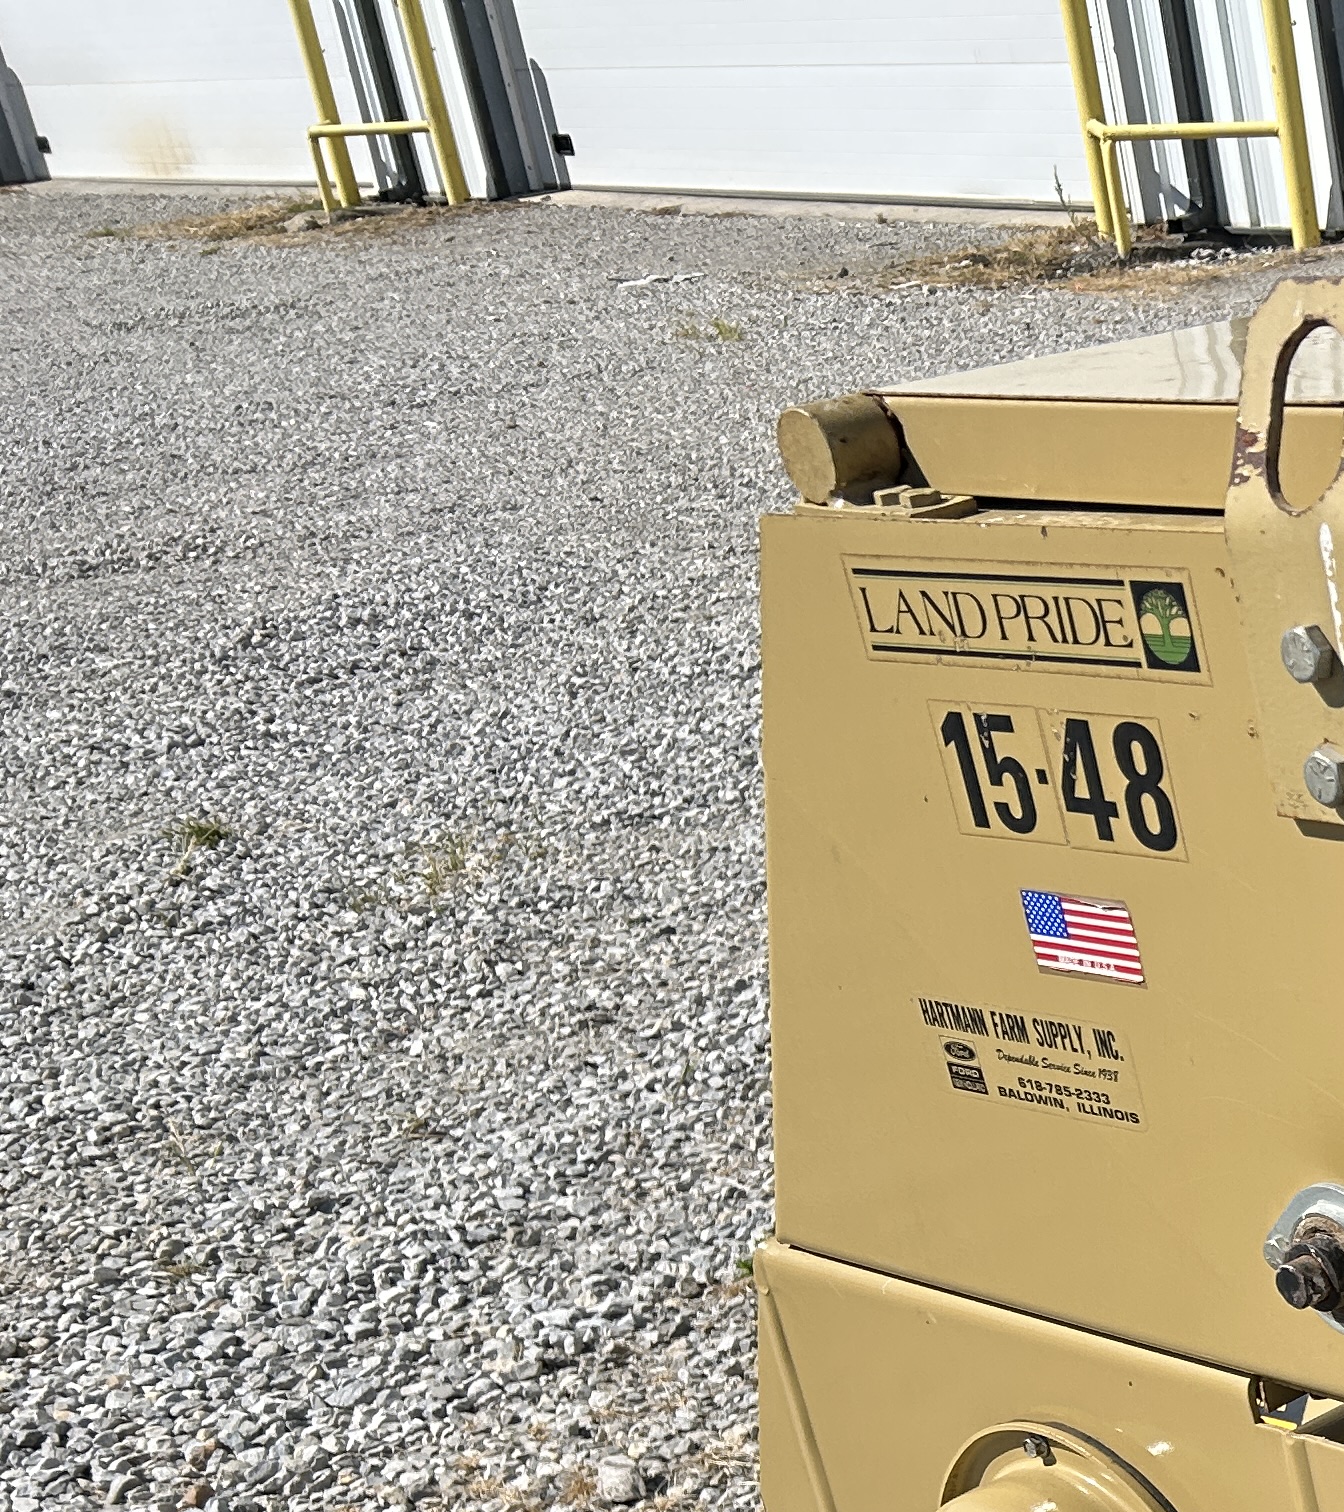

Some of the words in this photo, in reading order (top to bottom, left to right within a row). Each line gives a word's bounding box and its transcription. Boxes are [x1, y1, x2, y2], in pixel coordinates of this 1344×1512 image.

[858, 586, 988, 640] LAND
[991, 593, 1134, 649] PRIDE
[918, 998, 989, 1037] HARTMANN
[990, 1010, 1030, 1045] FARM
[1032, 1017, 1092, 1060] SUPPLY,
[1092, 1028, 1125, 1061] INC.
[951, 1065, 980, 1078] FORD
[995, 1049, 1040, 1068] Dependable
[1041, 1057, 1071, 1074] Service
[1073, 1063, 1096, 1079] Since
[997, 1086, 1071, 1112] BALDWIN,
[1076, 1101, 1141, 1124] ILLINOIS
[1017, 1076, 1111, 1105] 618-785-2333
